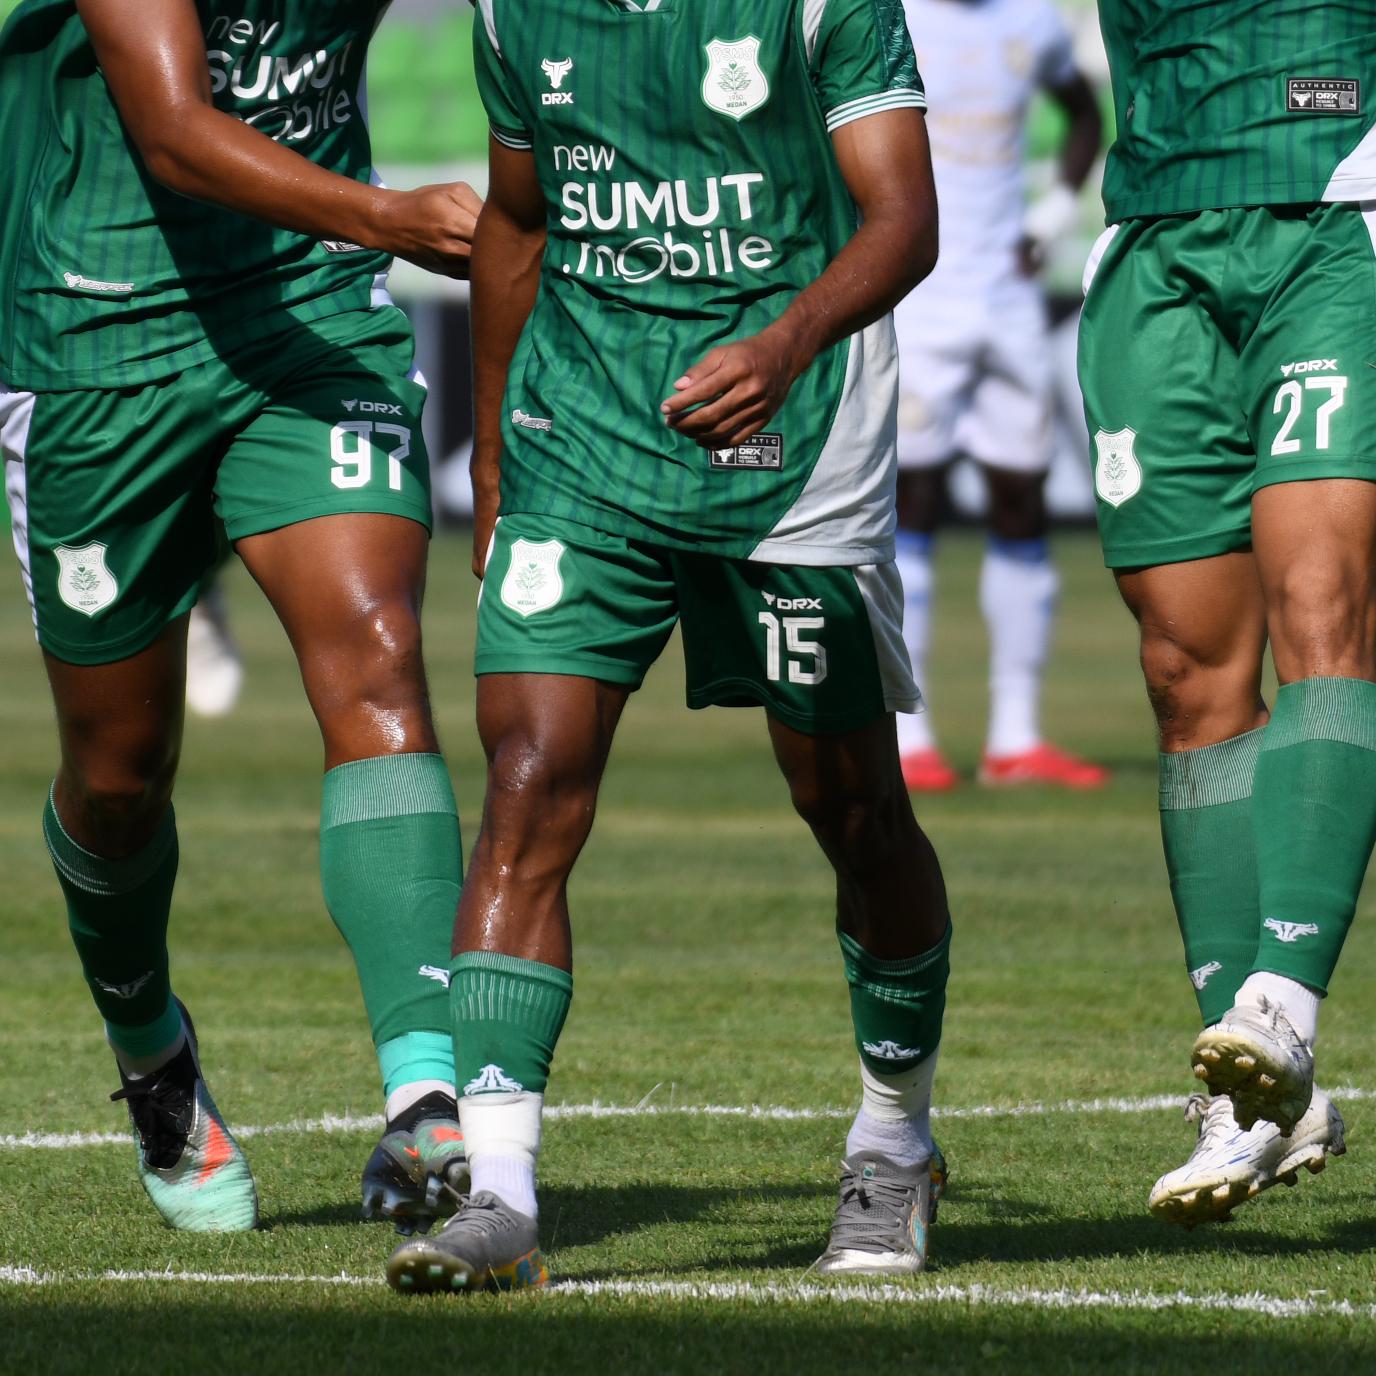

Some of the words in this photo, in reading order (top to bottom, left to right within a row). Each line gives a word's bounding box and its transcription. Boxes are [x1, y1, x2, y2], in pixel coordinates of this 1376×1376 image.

[232, 86, 352, 141] obile
[542, 92, 574, 105] DRX
[553, 145, 615, 171] new
[560, 173, 763, 230] SUMUT
[562, 228, 773, 283] .mobile
[1294, 358, 1338, 374] DRX
[359, 401, 403, 416] DRX
[1271, 376, 1347, 456] 27
[330, 421, 411, 491] 97
[738, 447, 761, 456] DRX
[776, 597, 823, 610] DRX
[758, 611, 827, 684] 15
